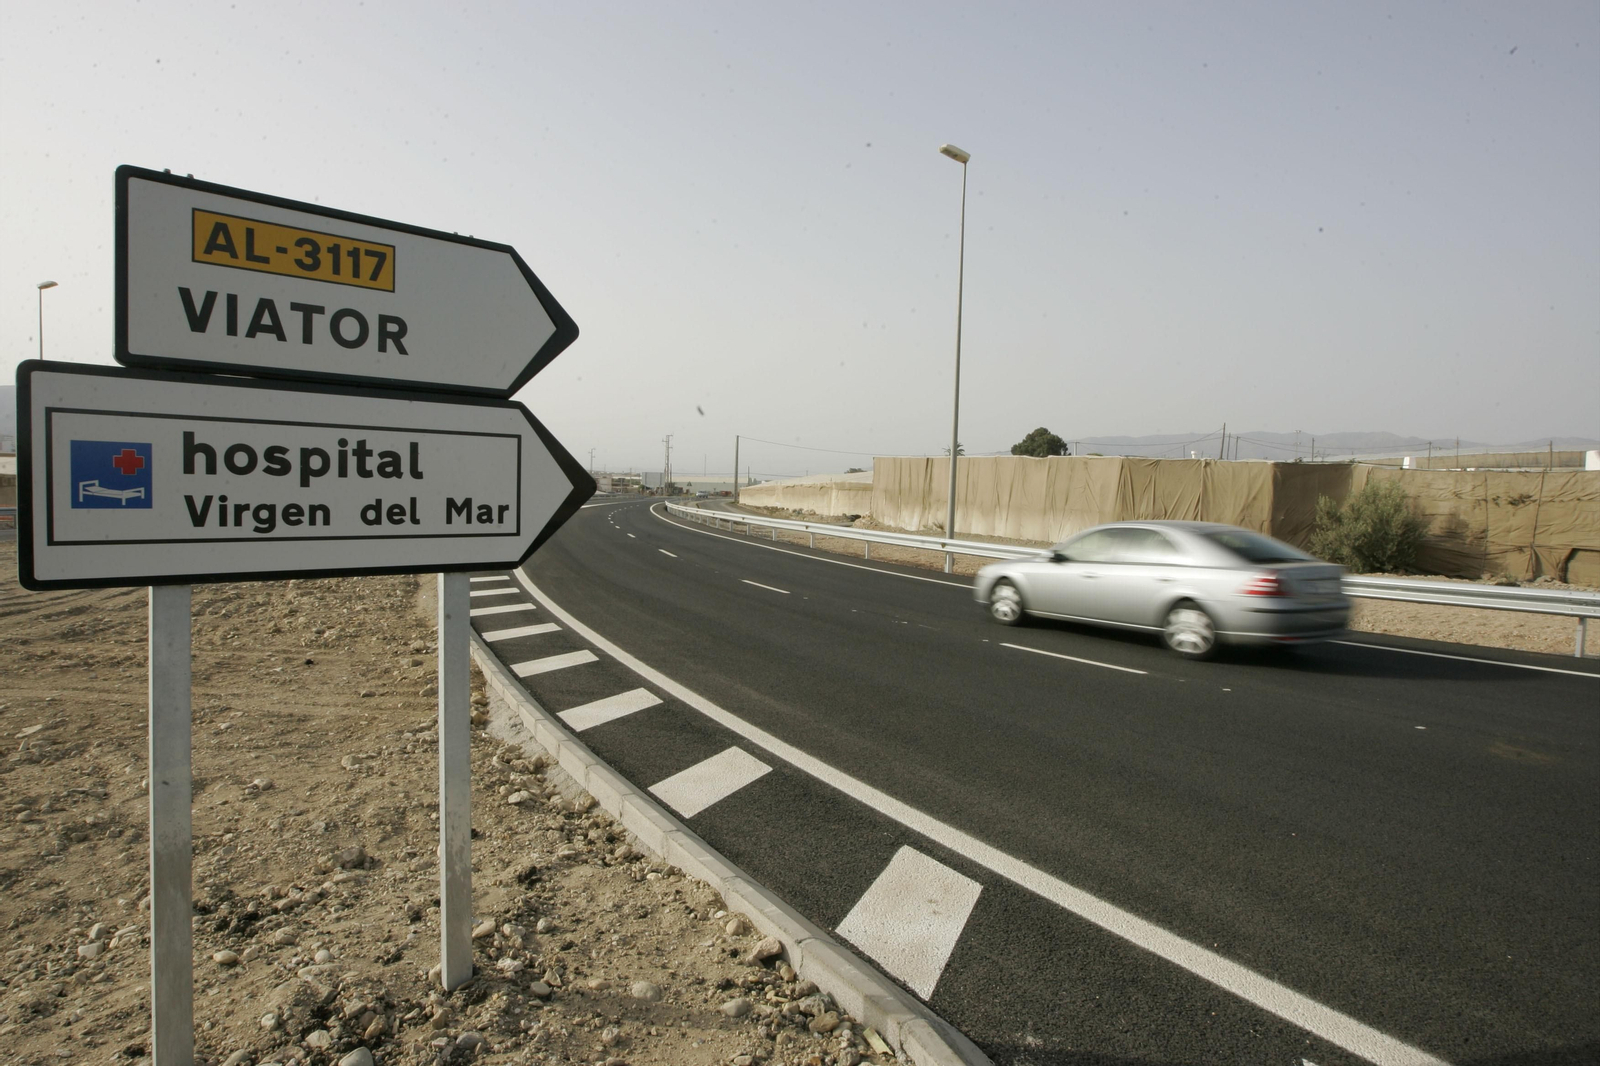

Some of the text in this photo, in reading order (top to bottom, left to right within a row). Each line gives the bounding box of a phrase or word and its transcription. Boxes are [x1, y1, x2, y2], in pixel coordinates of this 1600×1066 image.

[203, 221, 388, 282] AL-3117
[178, 286, 409, 355] VIATOR
[183, 431, 424, 487] hospital
[184, 494, 510, 535] Virgen del Mar
